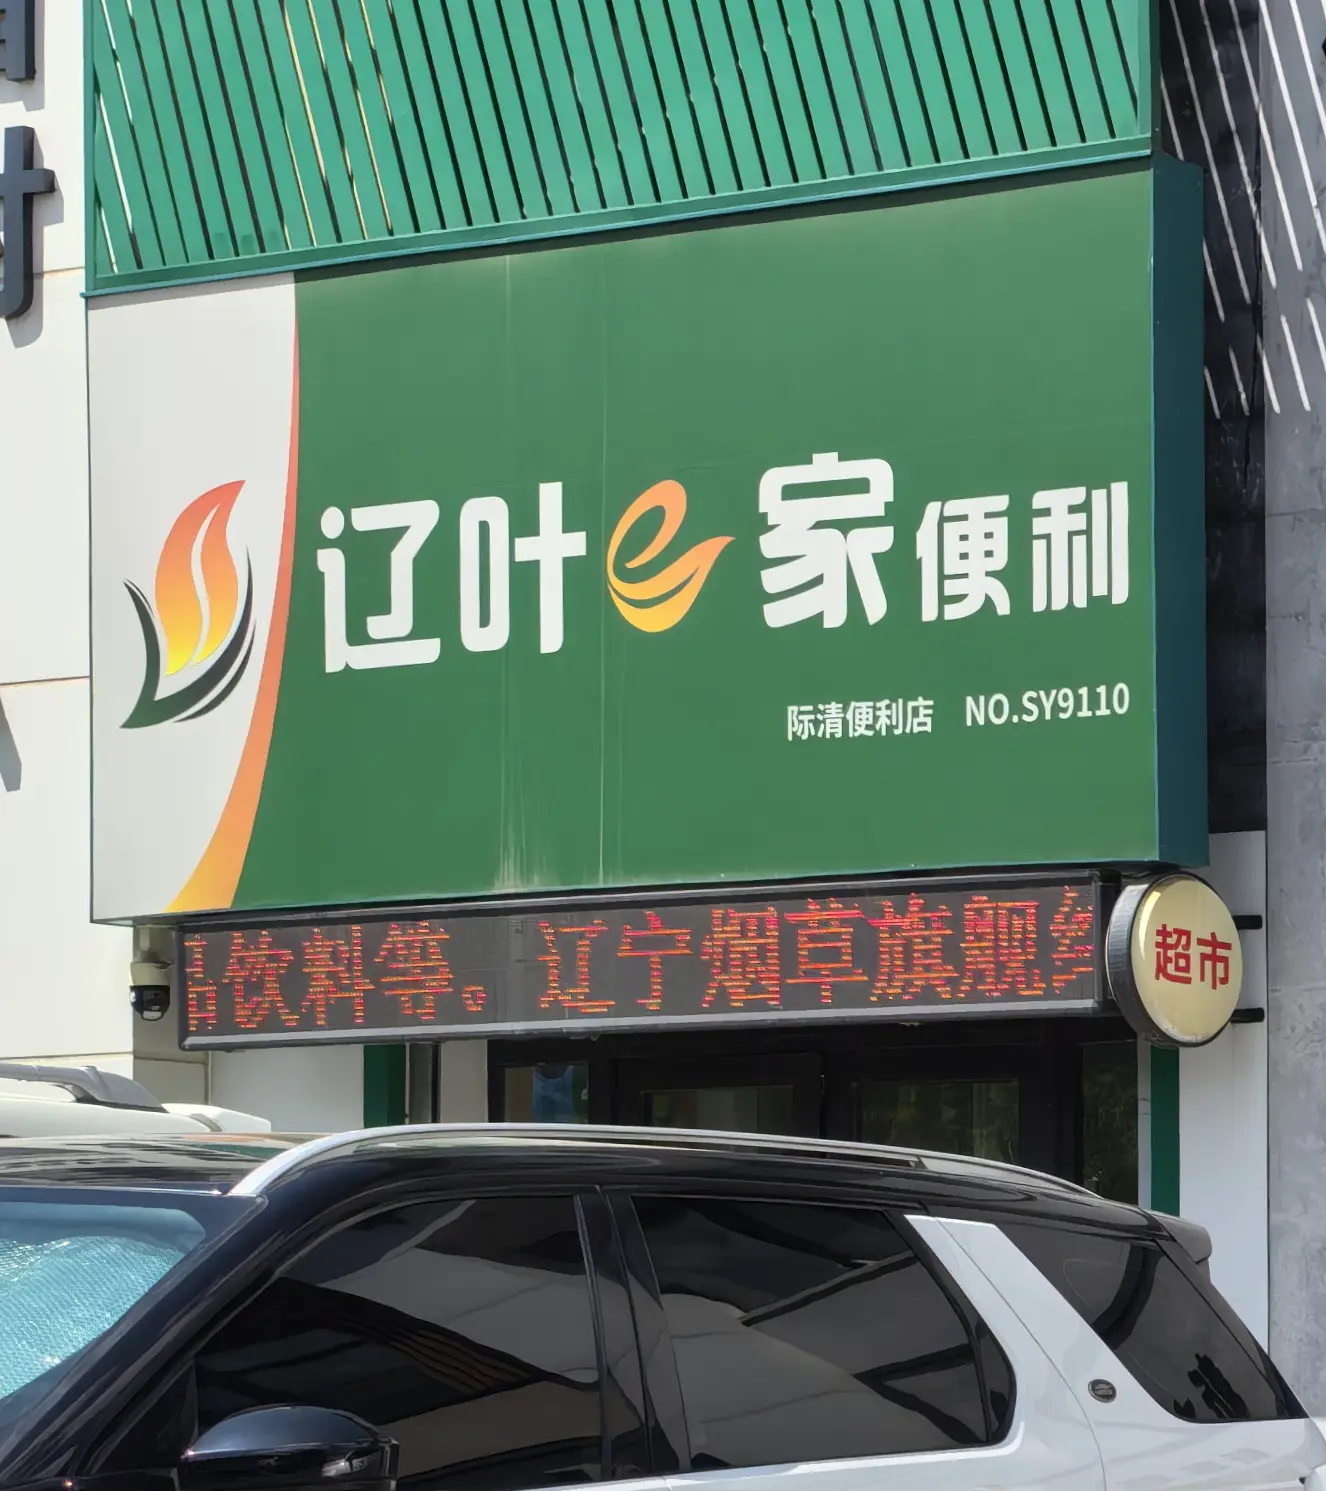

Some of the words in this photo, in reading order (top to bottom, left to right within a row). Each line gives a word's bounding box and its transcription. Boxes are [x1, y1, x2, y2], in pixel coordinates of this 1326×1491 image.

[787, 698, 934, 742] 际清便利店
[966, 682, 1130, 726] NO.SY9110
[1155, 924, 1232, 991] 超市
